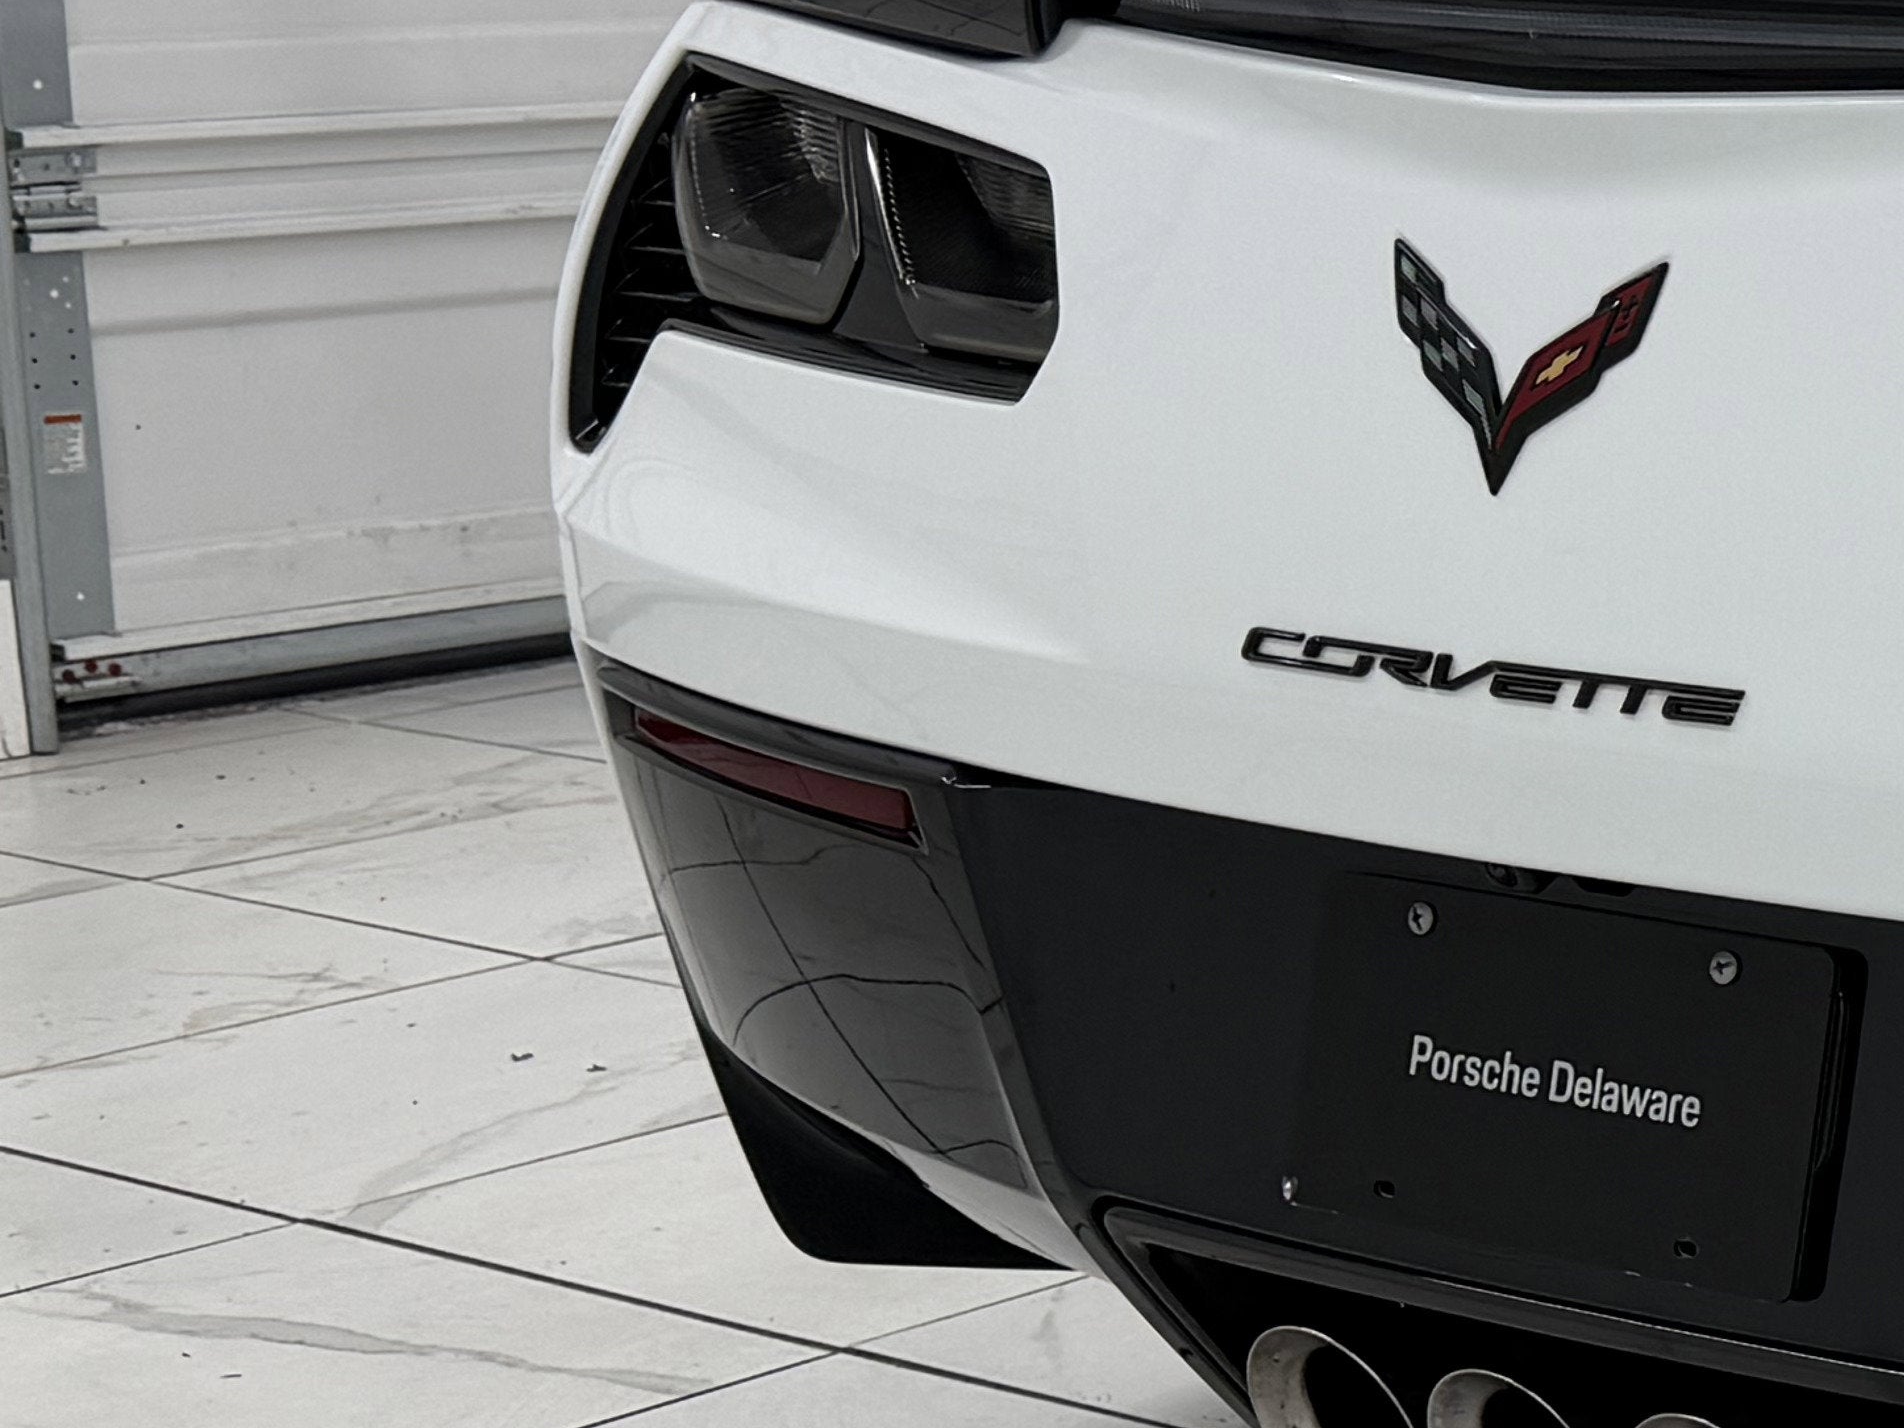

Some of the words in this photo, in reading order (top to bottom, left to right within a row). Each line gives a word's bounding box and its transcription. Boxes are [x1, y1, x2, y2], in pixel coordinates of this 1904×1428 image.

[1241, 627, 1745, 726] CORVETTE
[1410, 1035, 1540, 1097] Porsche
[1549, 1060, 1700, 1127] Delaware
